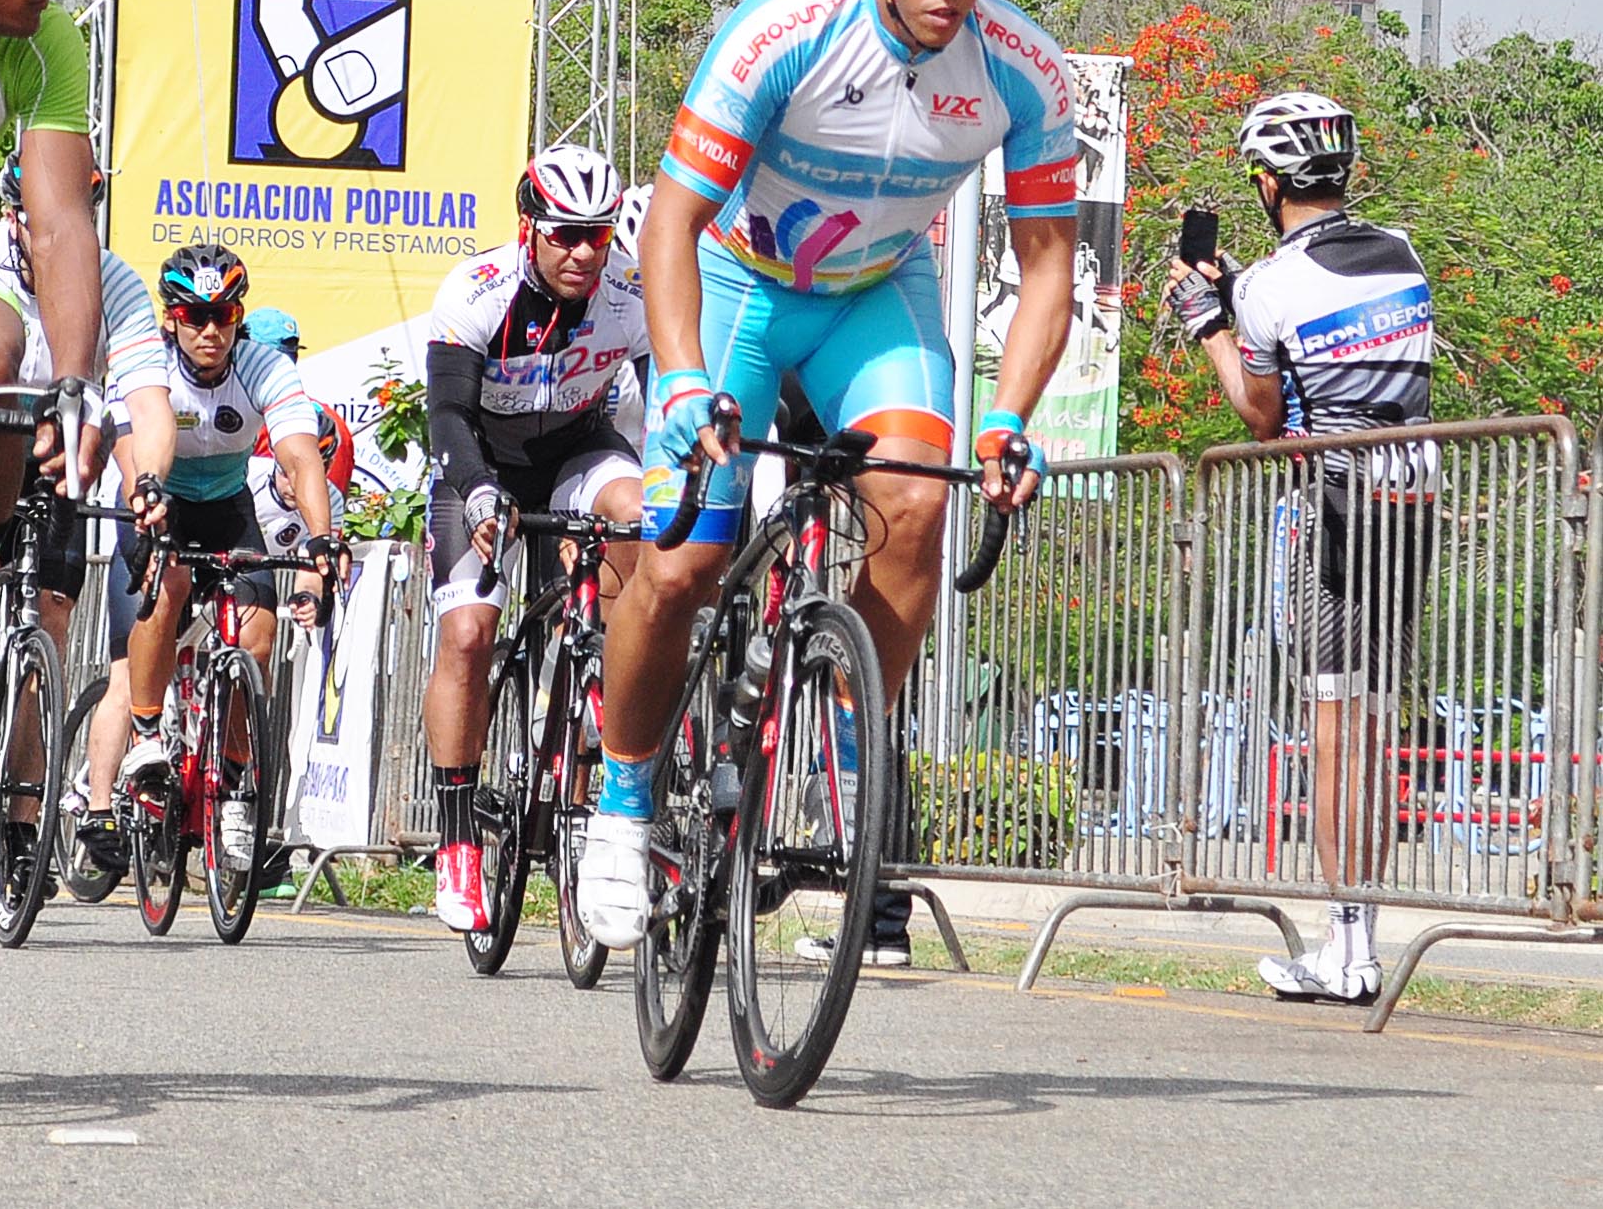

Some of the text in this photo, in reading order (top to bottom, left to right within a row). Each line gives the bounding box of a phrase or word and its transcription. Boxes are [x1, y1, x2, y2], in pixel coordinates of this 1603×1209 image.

[932, 93, 982, 118] V2C
[154, 179, 477, 229] ASOCIACION POPULAR
[152, 223, 477, 257] DE AHORROS Y PRESTAMOS
[197, 274, 221, 292] 706
[1338, 339, 1376, 356] CASH
[334, 397, 385, 424] niza
